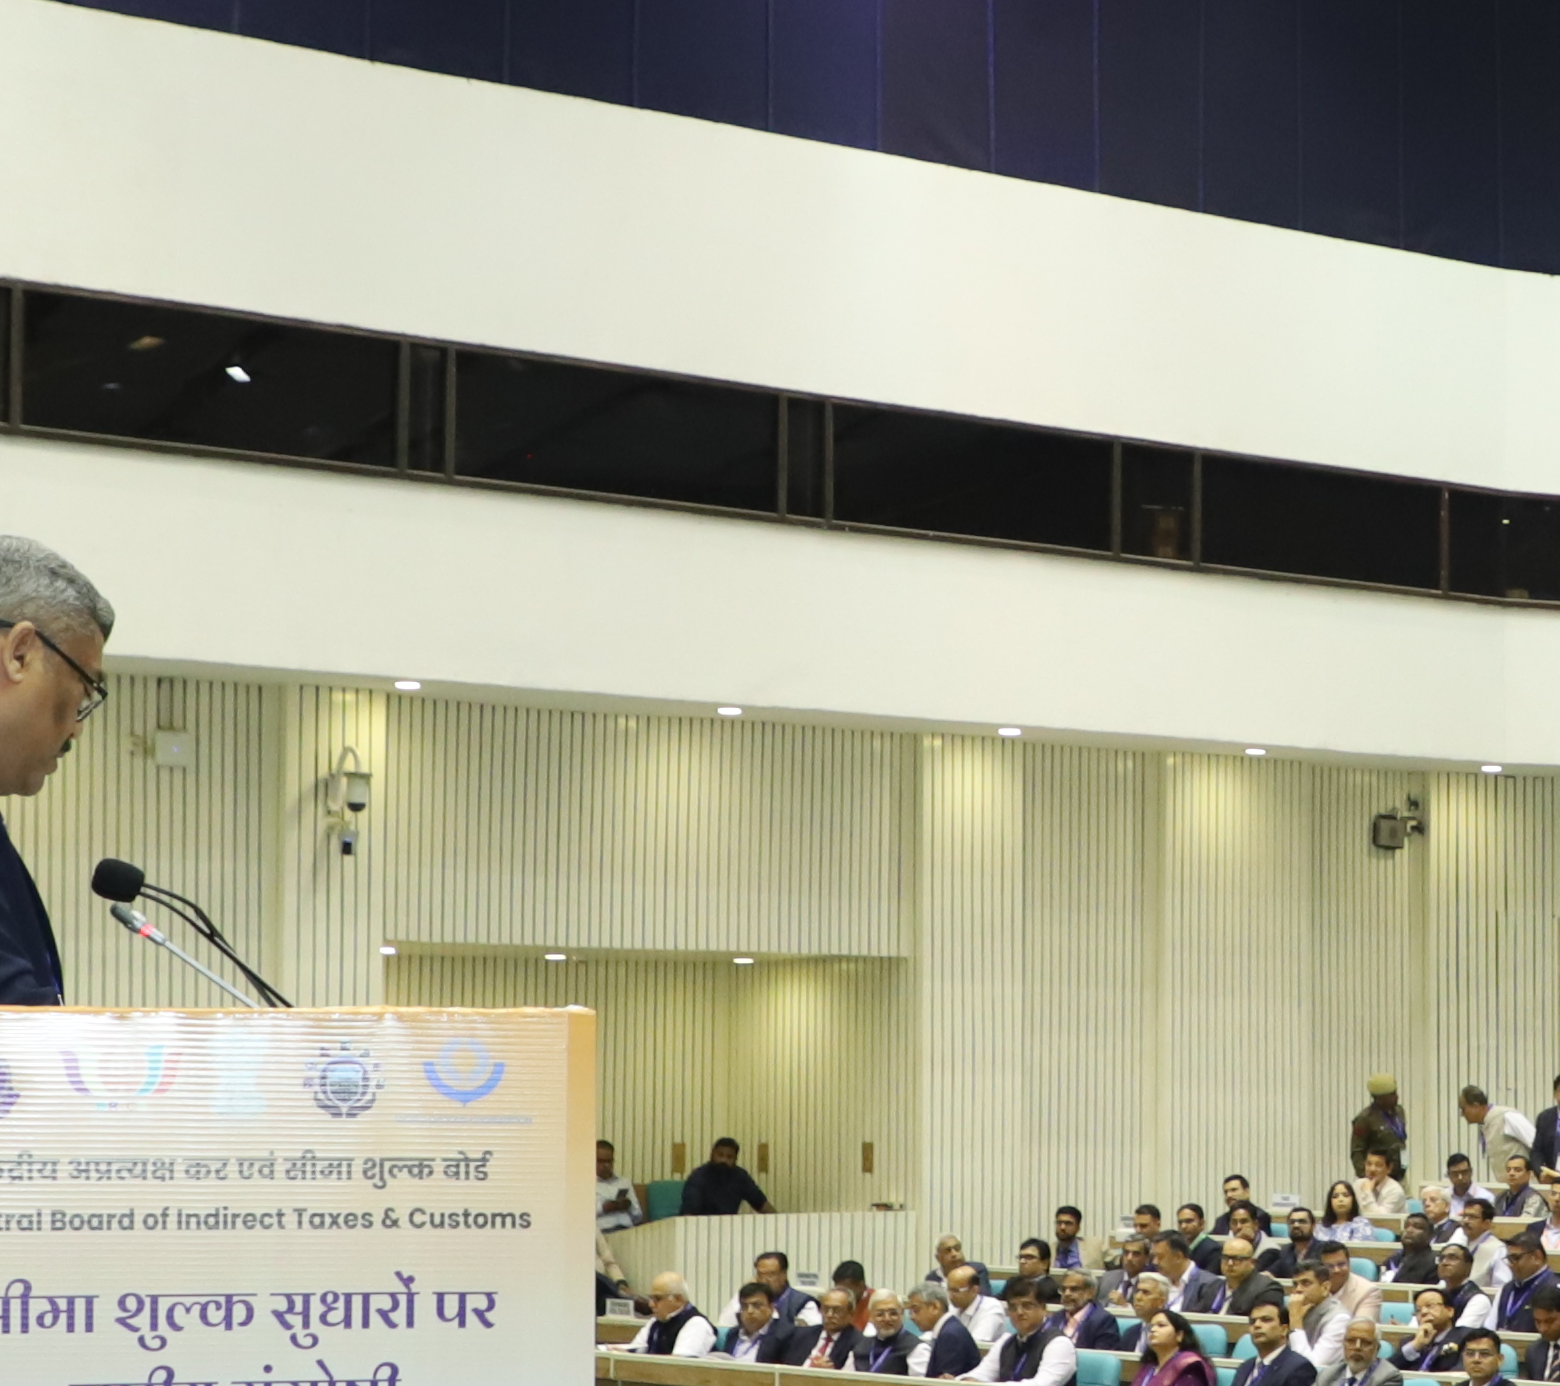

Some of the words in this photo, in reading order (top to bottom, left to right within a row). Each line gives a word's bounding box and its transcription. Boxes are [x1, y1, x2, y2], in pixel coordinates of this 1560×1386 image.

[182, 1158, 230, 1181] कर
[237, 1151, 275, 1180] एवं
[283, 1149, 354, 1181] सीमा
[361, 1157, 436, 1189] शुल्क
[441, 1151, 493, 1181] बोर्ड
[50, 1208, 135, 1231] Board
[142, 1206, 170, 1230] of
[176, 1207, 286, 1230] Indirect
[293, 1208, 374, 1230] Taxes
[380, 1208, 401, 1229] &
[407, 1208, 532, 1229] Customs
[115, 1291, 257, 1350] शुल्क
[270, 1271, 420, 1349] सुधारों
[433, 1290, 497, 1330] पर
